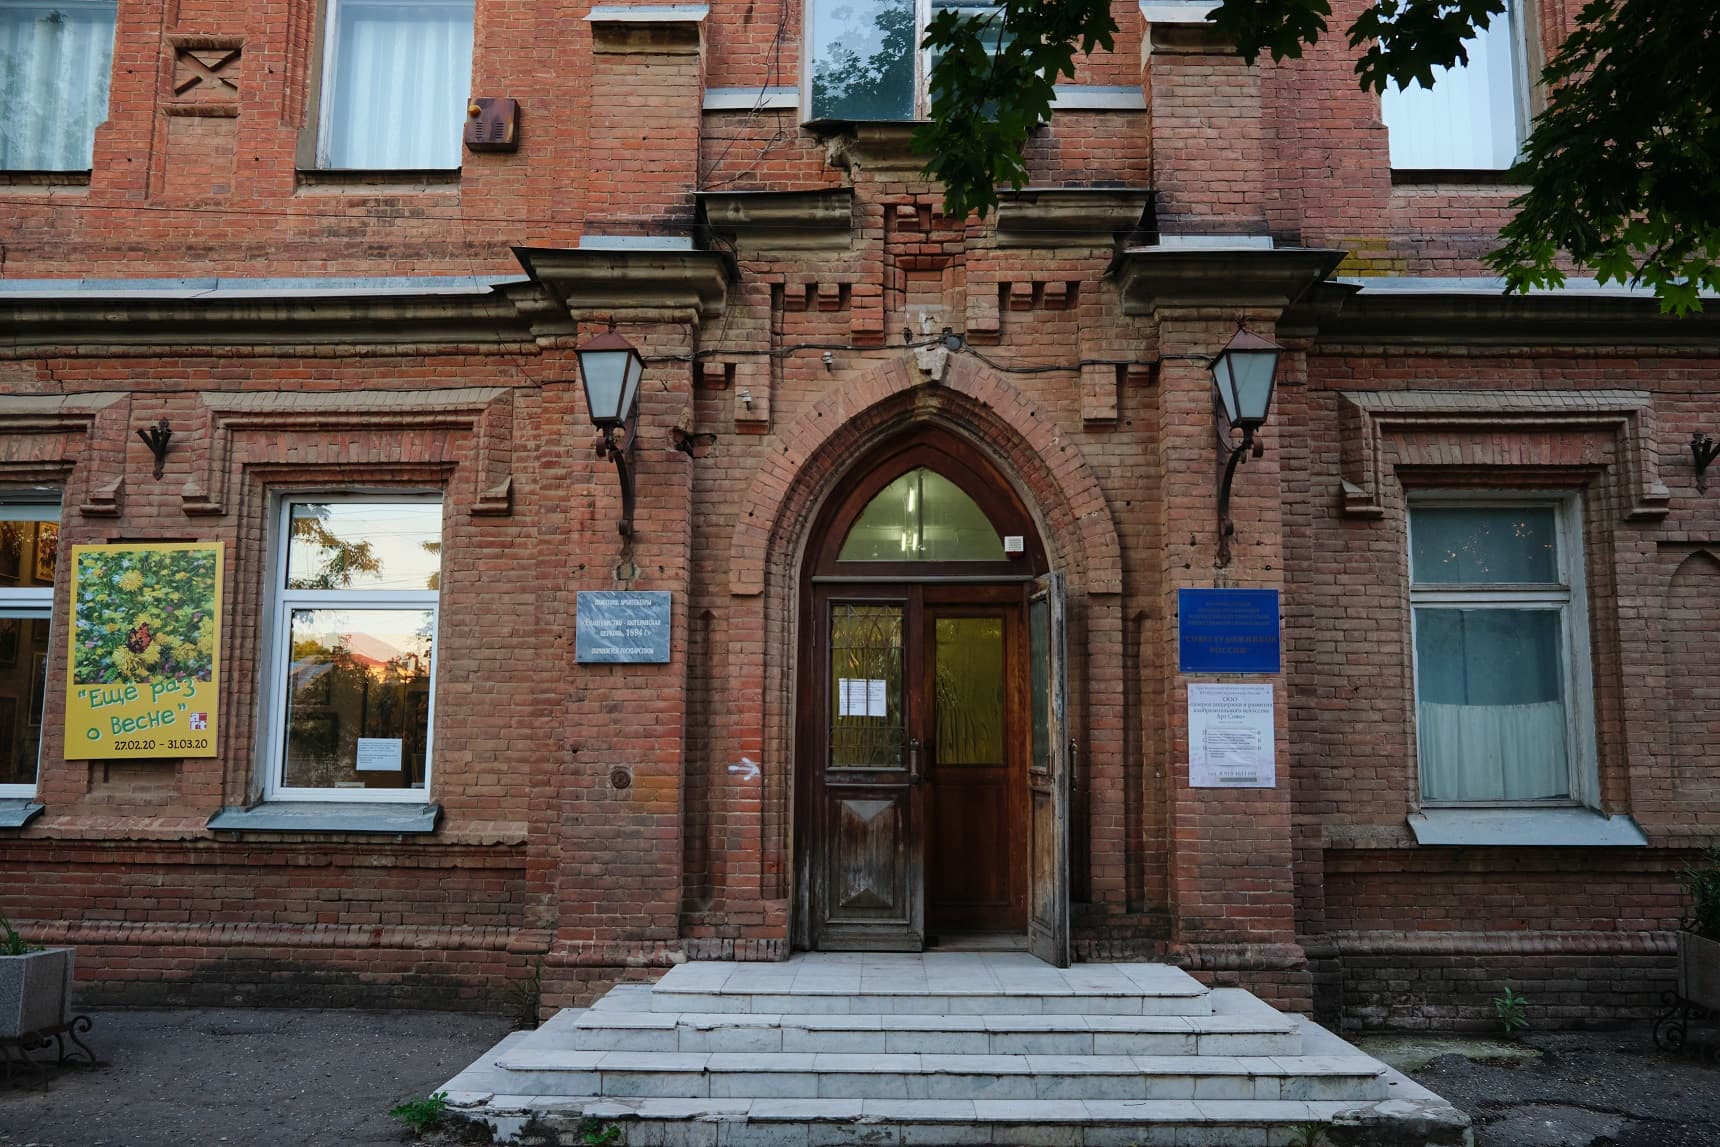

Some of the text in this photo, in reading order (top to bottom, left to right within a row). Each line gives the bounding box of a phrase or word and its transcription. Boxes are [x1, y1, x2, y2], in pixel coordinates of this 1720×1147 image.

[151, 677, 196, 702] раз
[86, 727, 101, 740] о
[114, 740, 156, 750] 27.02.20
[167, 739, 208, 749] 31.03.20
